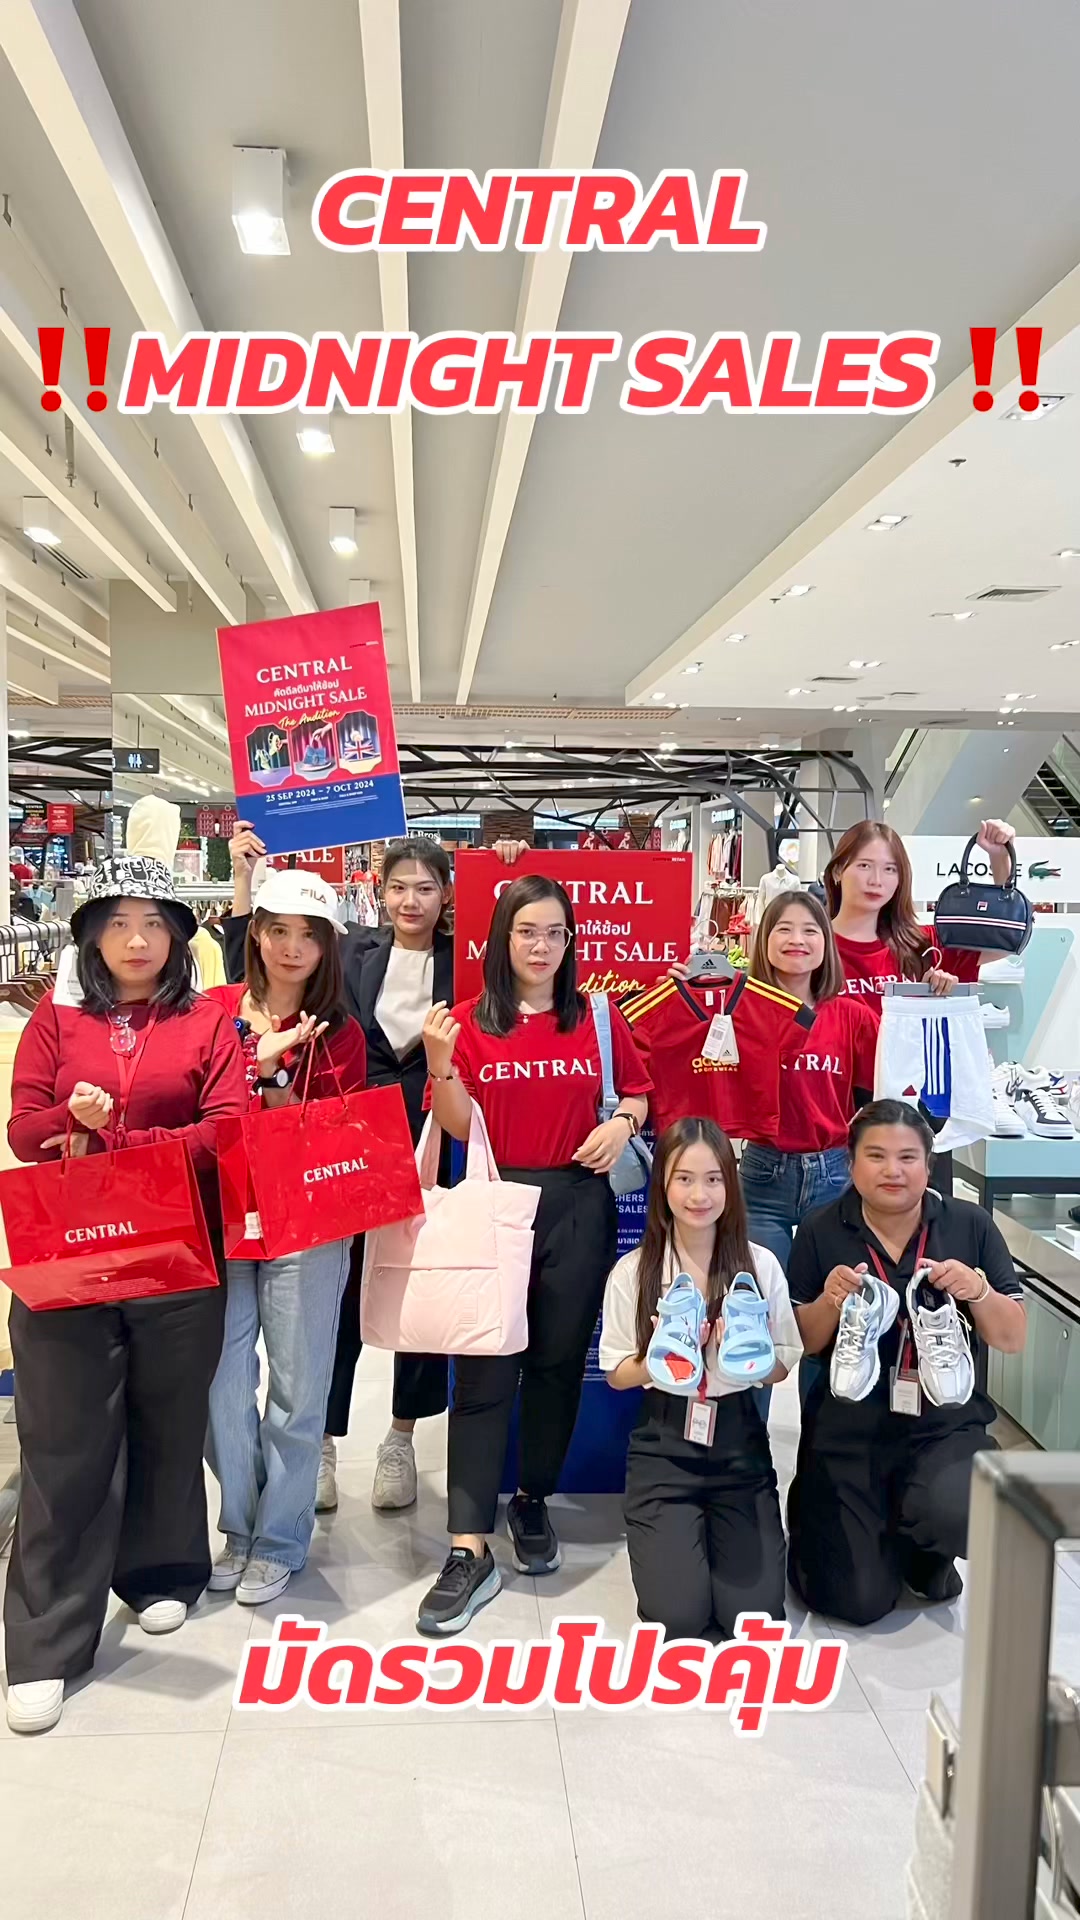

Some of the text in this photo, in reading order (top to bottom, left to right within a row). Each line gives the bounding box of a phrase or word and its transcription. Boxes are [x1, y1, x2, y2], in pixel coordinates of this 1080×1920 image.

[256, 655, 353, 684] CENTRAL
[244, 687, 368, 717] MIDNIGHT SALE
[279, 708, 341, 729] The Audition
[266, 794, 276, 803] 25
[278, 792, 294, 801] SEP
[296, 788, 316, 799] 2024
[326, 786, 331, 794] 7
[333, 783, 352, 793] OCT
[354, 779, 374, 790] 2024
[300, 888, 327, 904] FILA
[493, 879, 653, 905] CTRAL
[614, 941, 679, 962] SALE
[479, 1058, 598, 1083] CENTRAL
[303, 1157, 369, 1184] CENTRAL
[65, 1221, 138, 1244] CENTRAL
